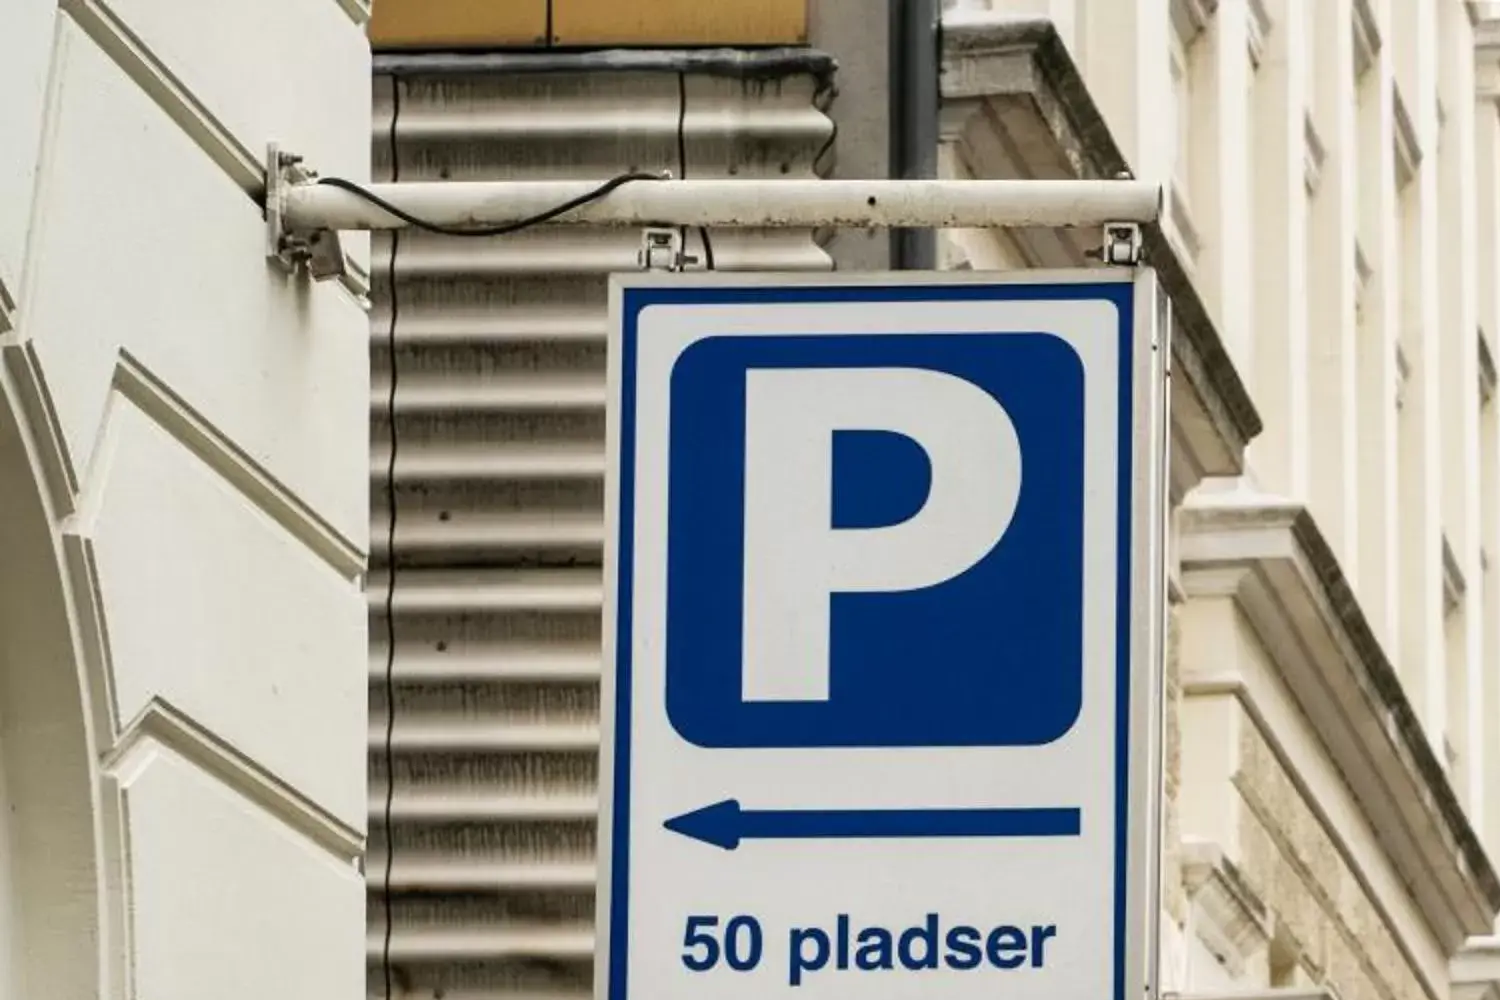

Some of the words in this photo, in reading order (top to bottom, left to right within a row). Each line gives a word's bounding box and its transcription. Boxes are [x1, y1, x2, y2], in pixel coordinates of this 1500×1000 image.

[742, 367, 1023, 703] P
[681, 914, 763, 972] 50
[788, 912, 1057, 987] pladser
